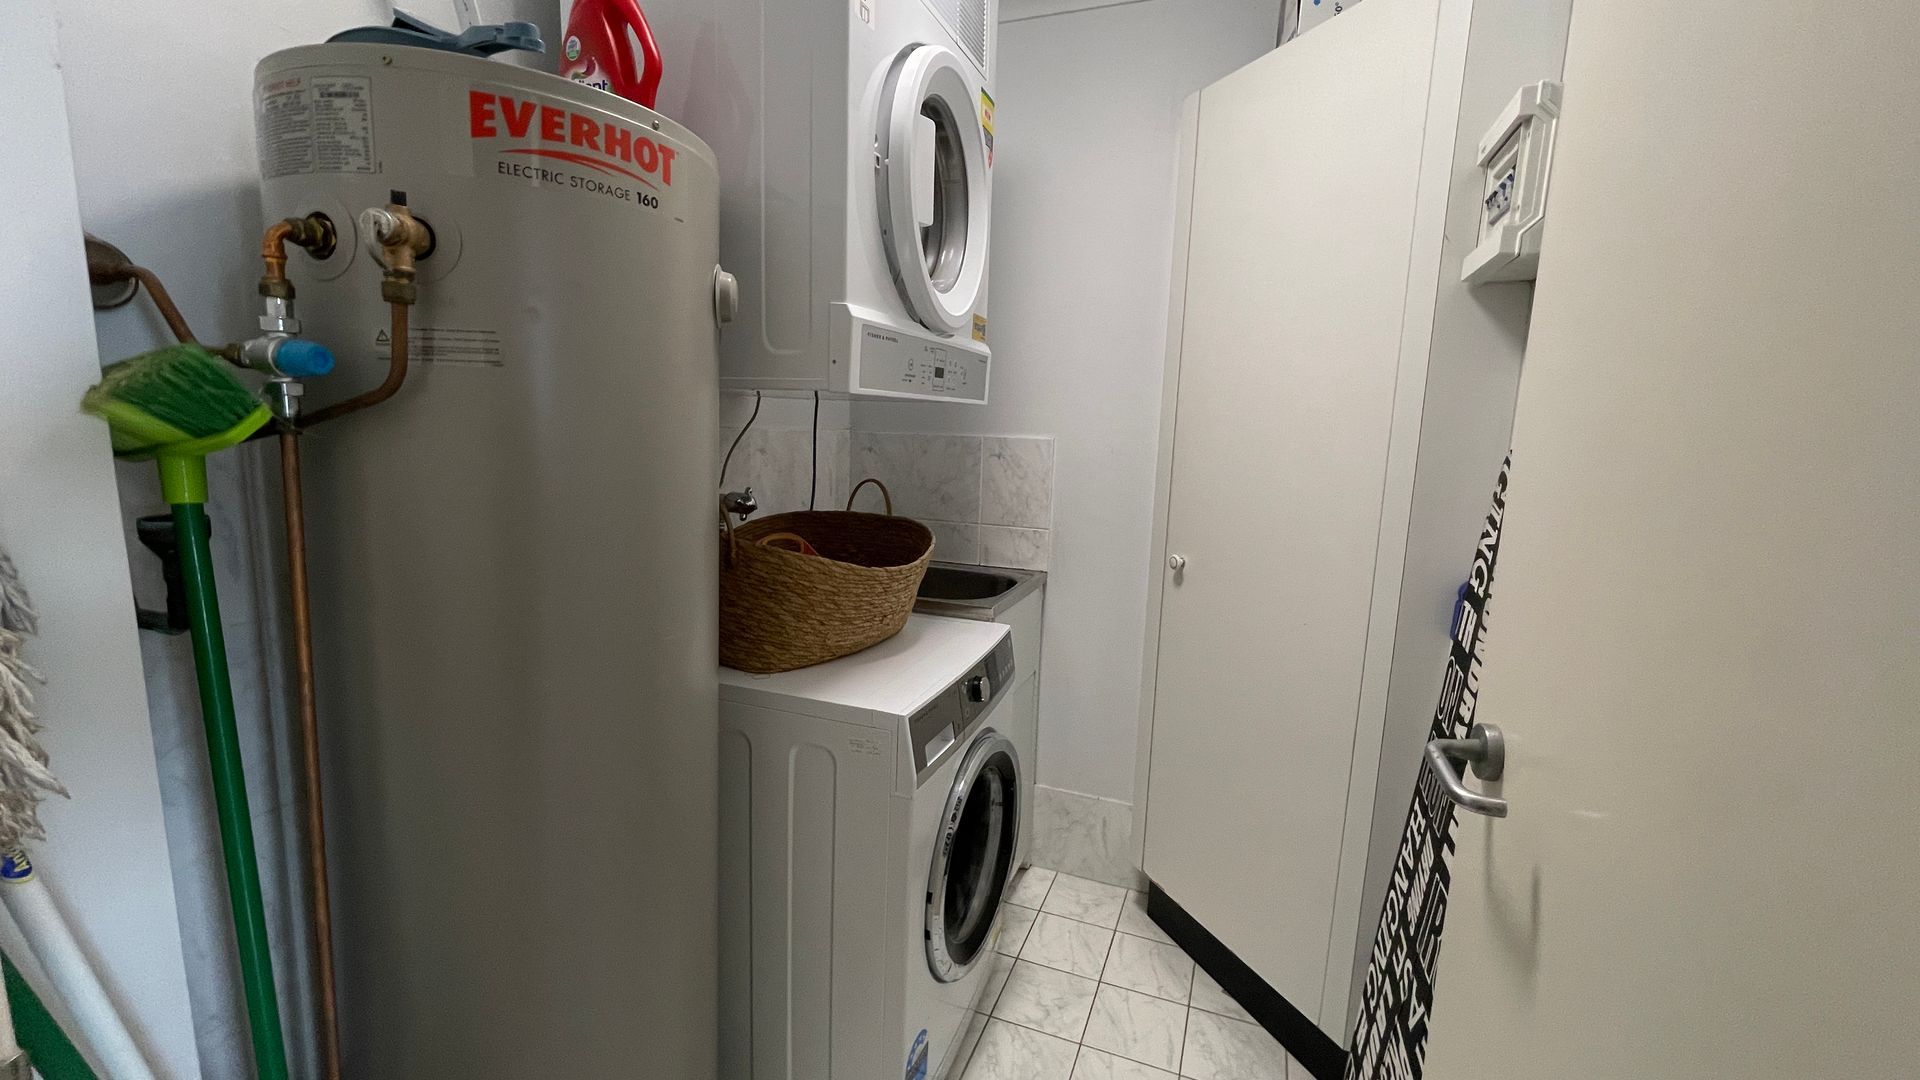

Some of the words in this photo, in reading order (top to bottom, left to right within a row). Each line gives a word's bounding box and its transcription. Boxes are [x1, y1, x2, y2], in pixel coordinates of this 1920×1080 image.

[469, 90, 678, 187] EVERHOT
[498, 161, 564, 185] ELECTRIC
[570, 175, 631, 201] STORAGE
[636, 191, 659, 209] 160
[1366, 797, 1427, 1015] HANGING
